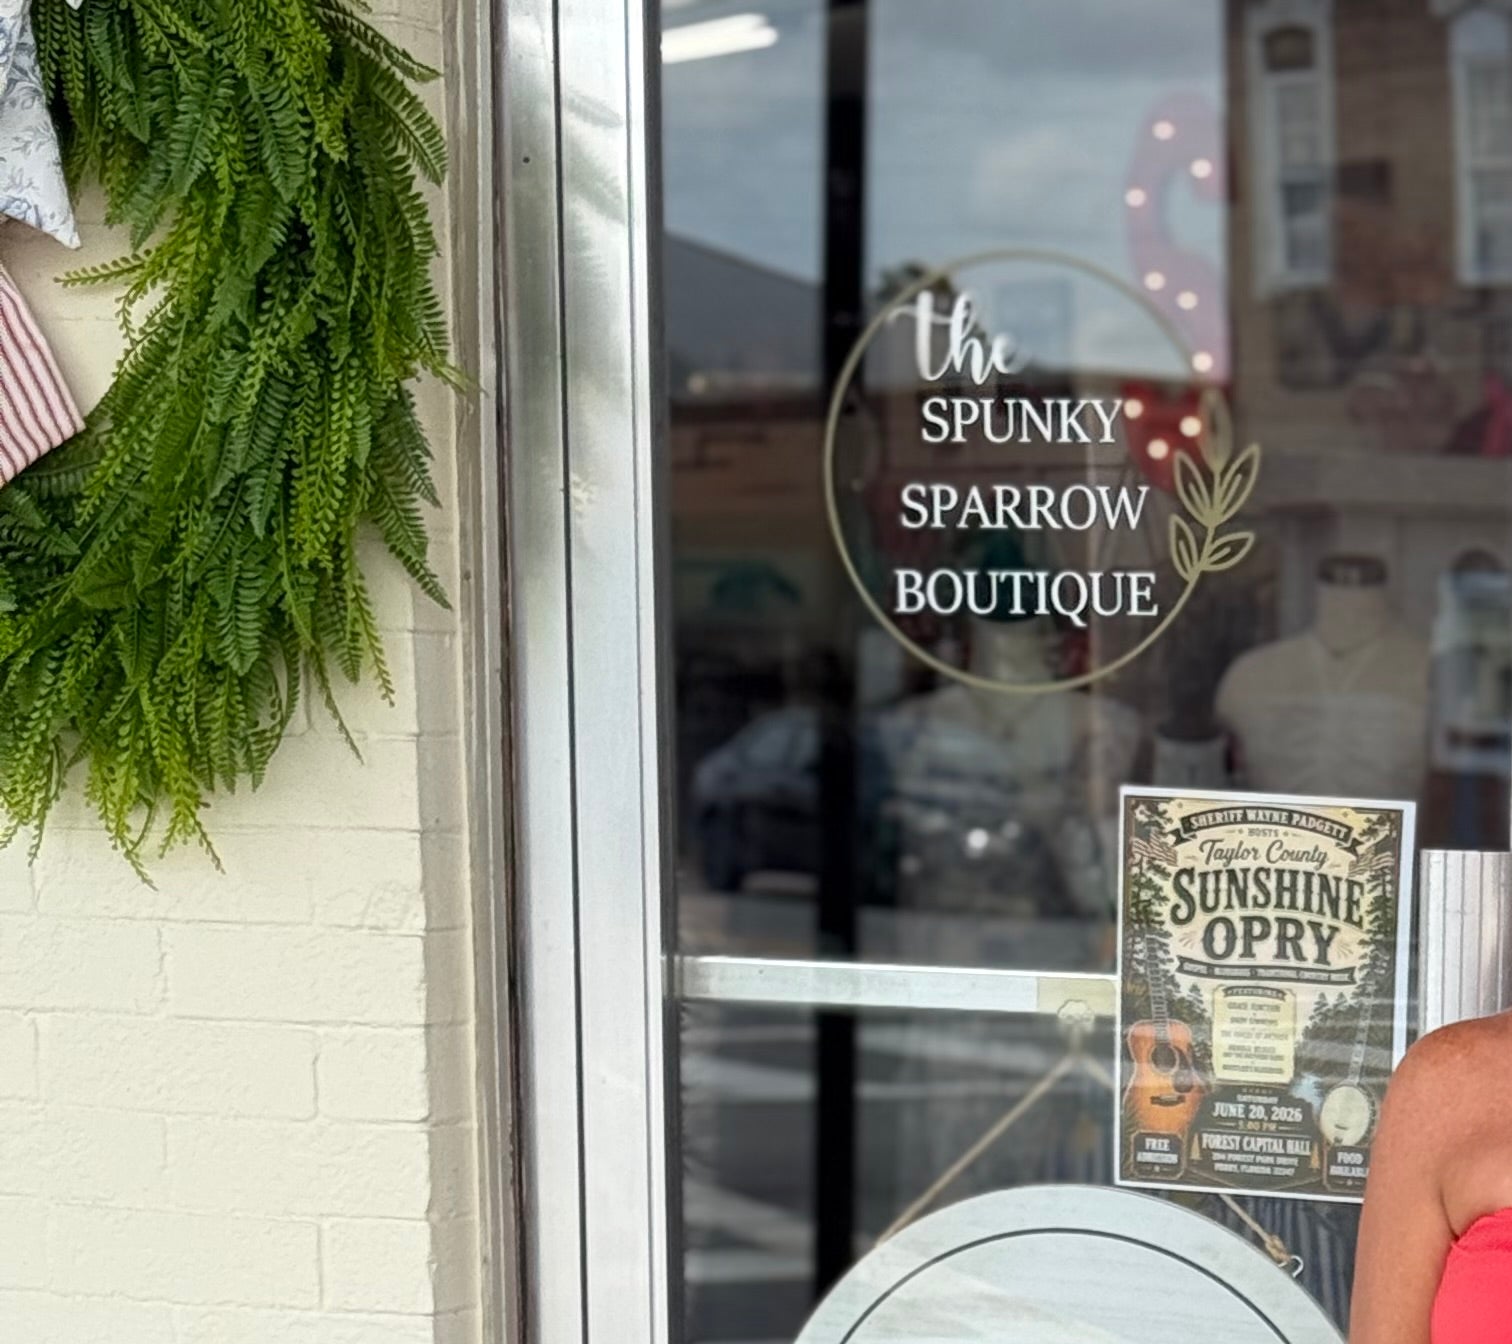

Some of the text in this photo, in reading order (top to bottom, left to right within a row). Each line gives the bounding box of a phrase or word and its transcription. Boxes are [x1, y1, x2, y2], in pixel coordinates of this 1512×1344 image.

[887, 290, 1023, 385] the
[921, 397, 1123, 444] SPUNKY
[900, 483, 1150, 531] SPARROW
[894, 568, 1159, 627] BOUTIQUE
[1190, 809, 1347, 839] SHERIFF WAYNE PADGETT
[1247, 828, 1280, 838] HOSTS
[1199, 839, 1328, 871] Taylor County
[1170, 866, 1365, 930] SUNSHINE
[1202, 916, 1340, 966] OPRY
[1212, 1103, 1303, 1122] JUNE 20, 2026
[1145, 1137, 1171, 1151] FREE
[1202, 1133, 1311, 1155] FOREST CAPITAL HALL
